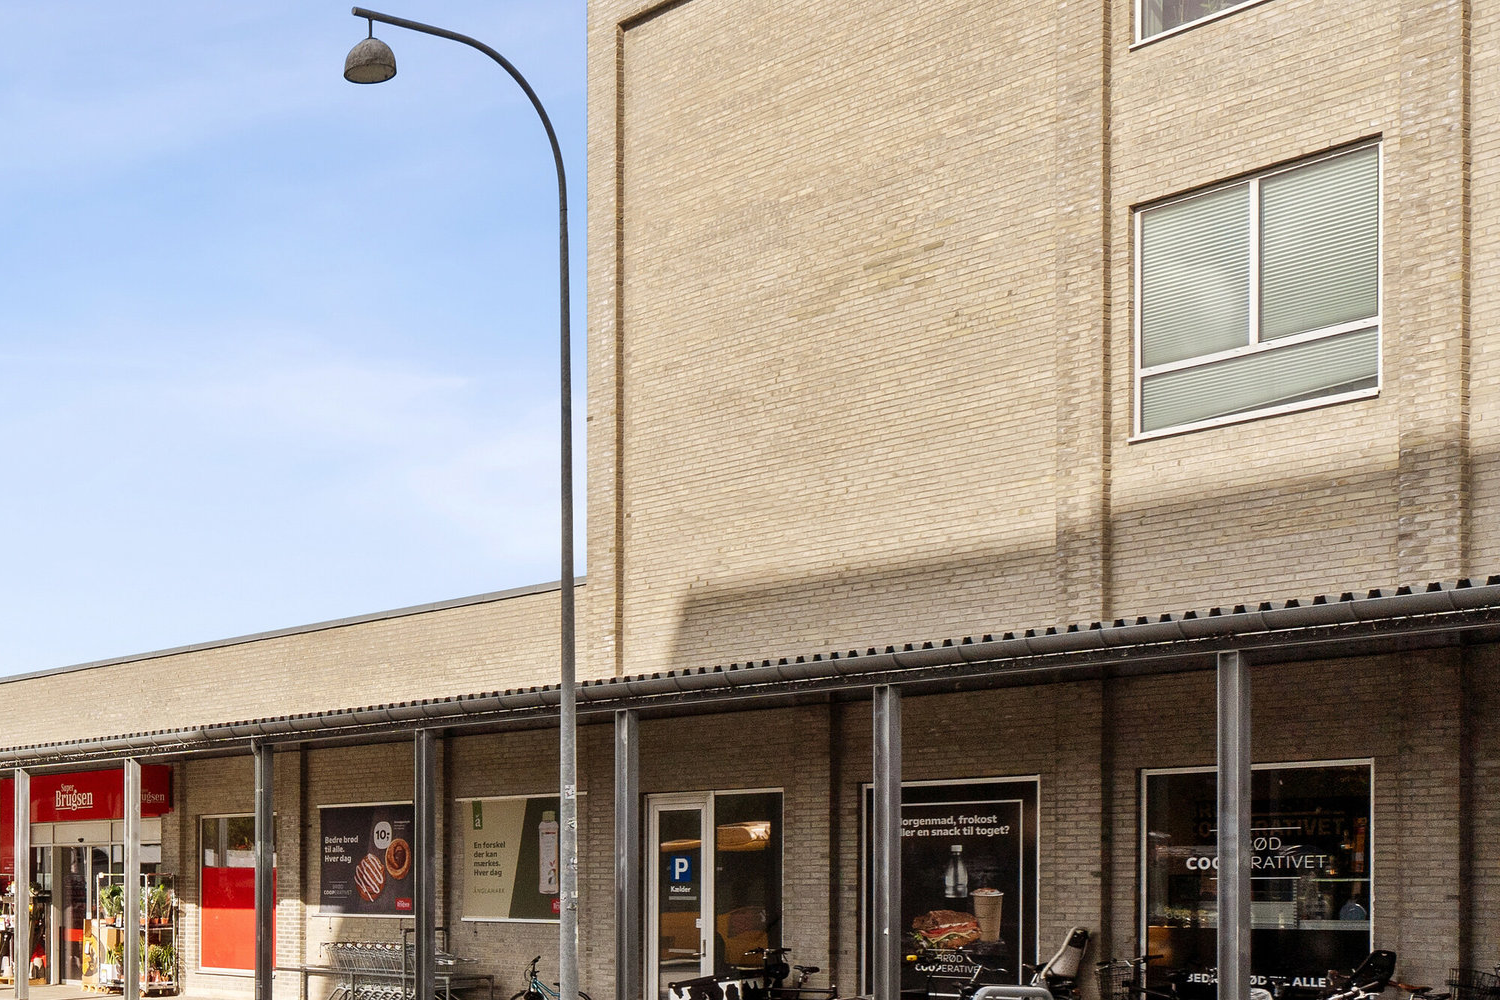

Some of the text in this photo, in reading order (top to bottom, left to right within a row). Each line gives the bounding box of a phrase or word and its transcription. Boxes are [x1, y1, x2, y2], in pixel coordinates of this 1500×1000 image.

[61, 783, 75, 793] Super
[55, 789, 93, 811] Brugsen
[141, 792, 165, 804] ugsen
[958, 815, 998, 825] frokost
[900, 825, 1010, 837] ller en snack til toget?
[324, 835, 359, 844] Bedre brød
[1250, 836, 1282, 851] ØD
[332, 845, 345, 853] alle.
[324, 855, 352, 864] Hver dag
[489, 869, 502, 877] dag
[675, 858, 689, 880] P
[670, 885, 691, 893] Kælder
[1250, 975, 1268, 986] ØD
[1291, 977, 1327, 988] ALLE
